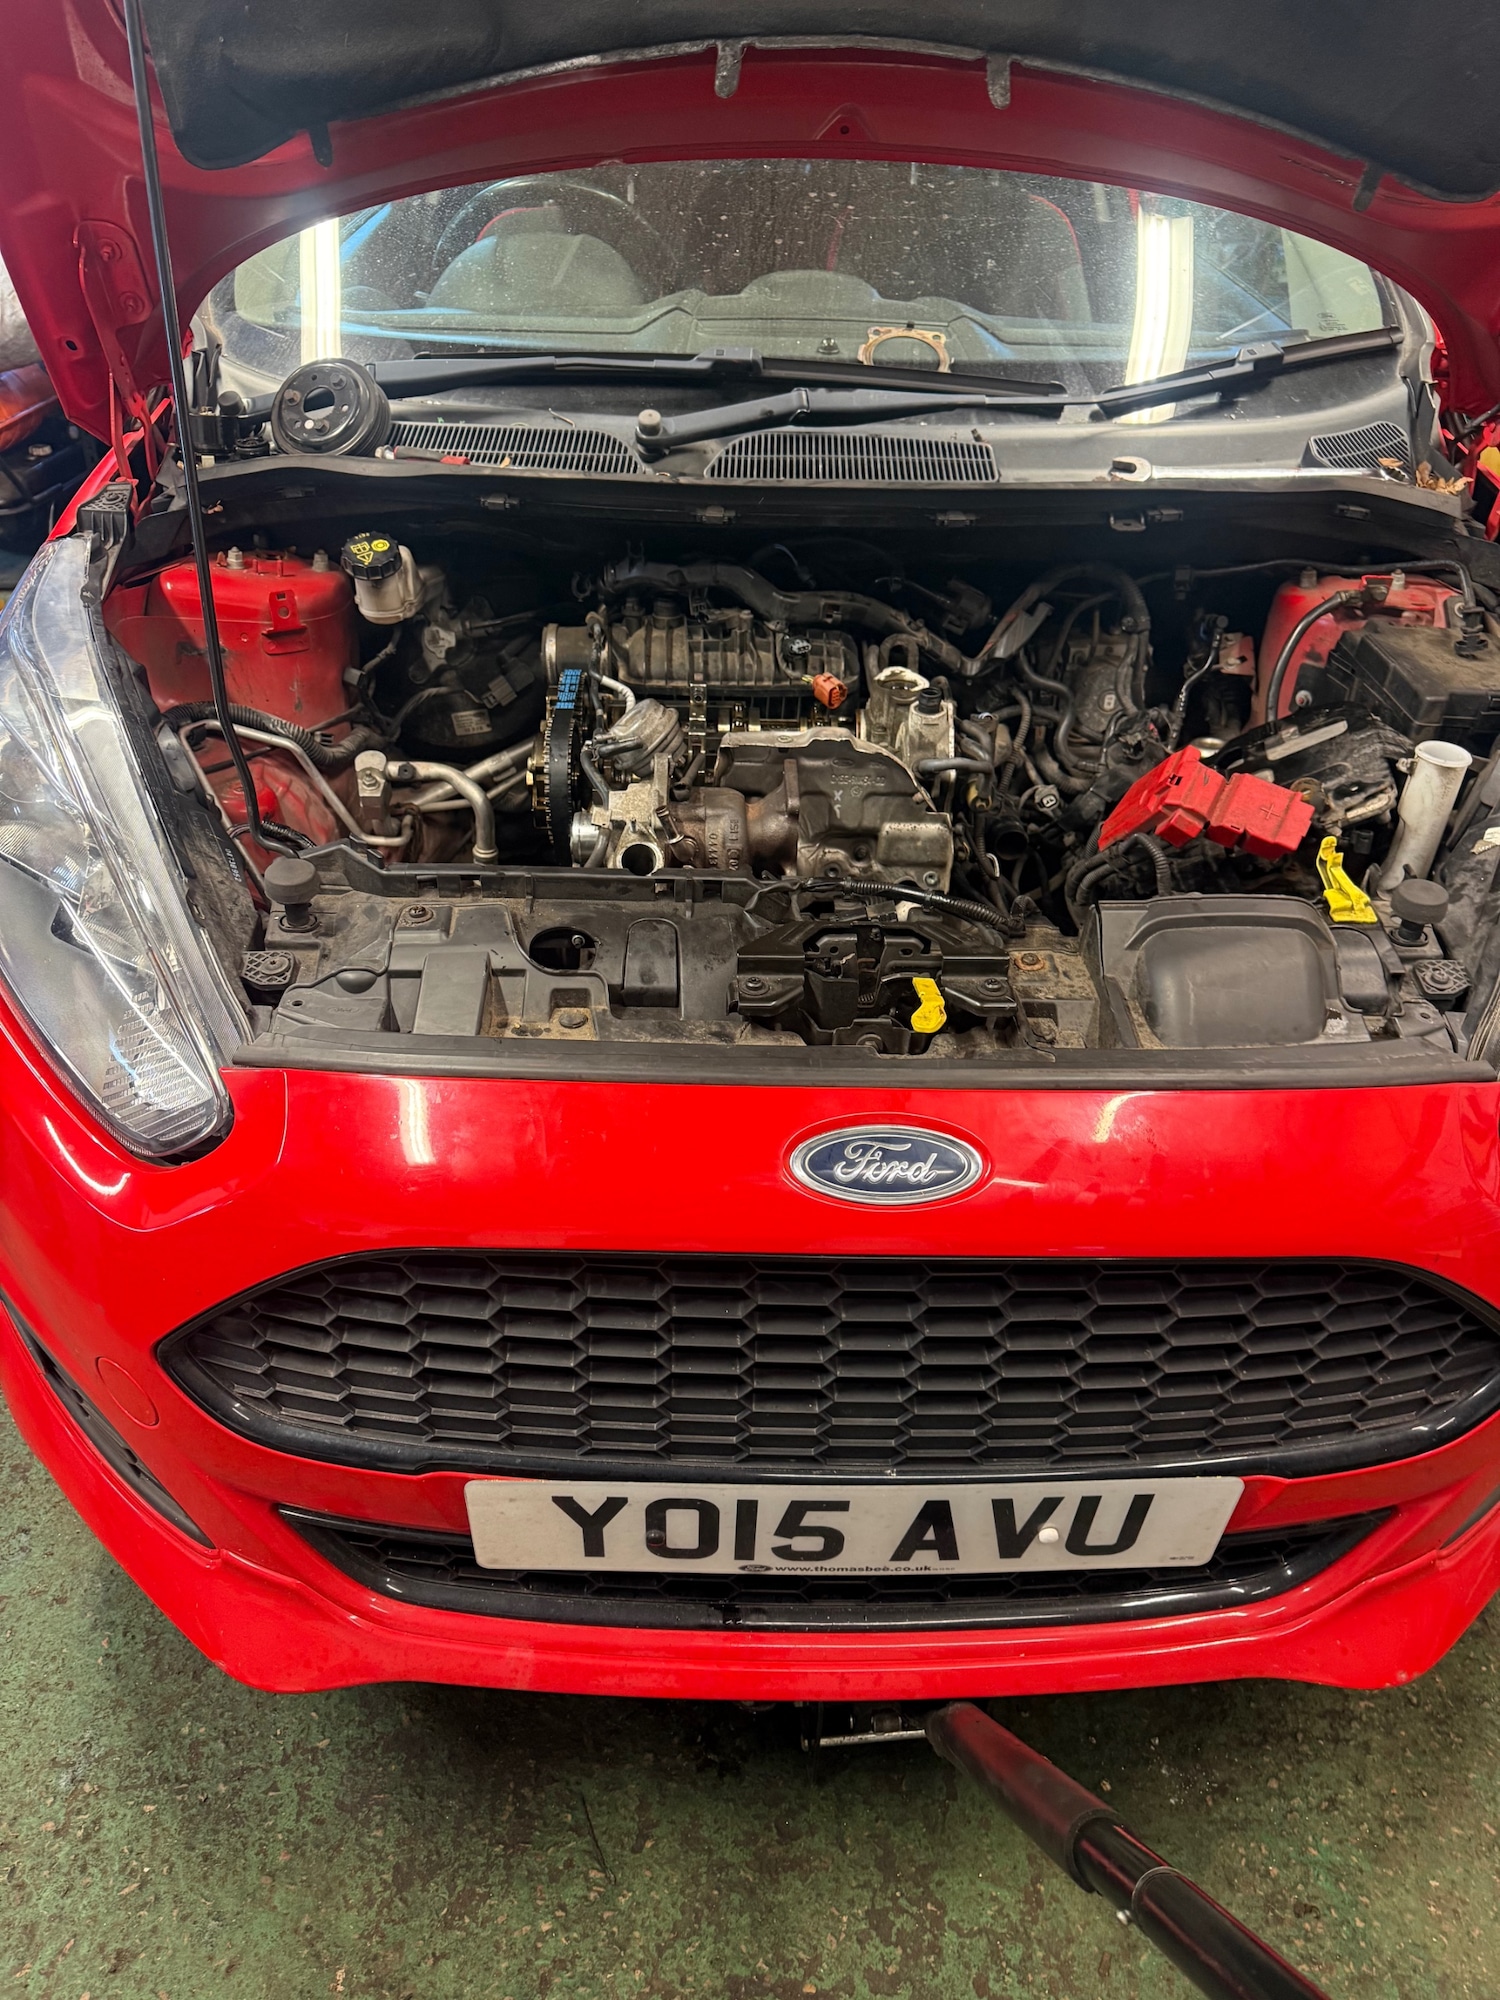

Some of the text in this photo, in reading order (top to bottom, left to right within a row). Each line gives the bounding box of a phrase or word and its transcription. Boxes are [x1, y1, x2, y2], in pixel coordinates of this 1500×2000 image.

[833, 1141, 939, 1184] Ford
[551, 1494, 1155, 1561] YO15 AVU
[775, 1565, 932, 1573] www.thomasbee.co.uk
